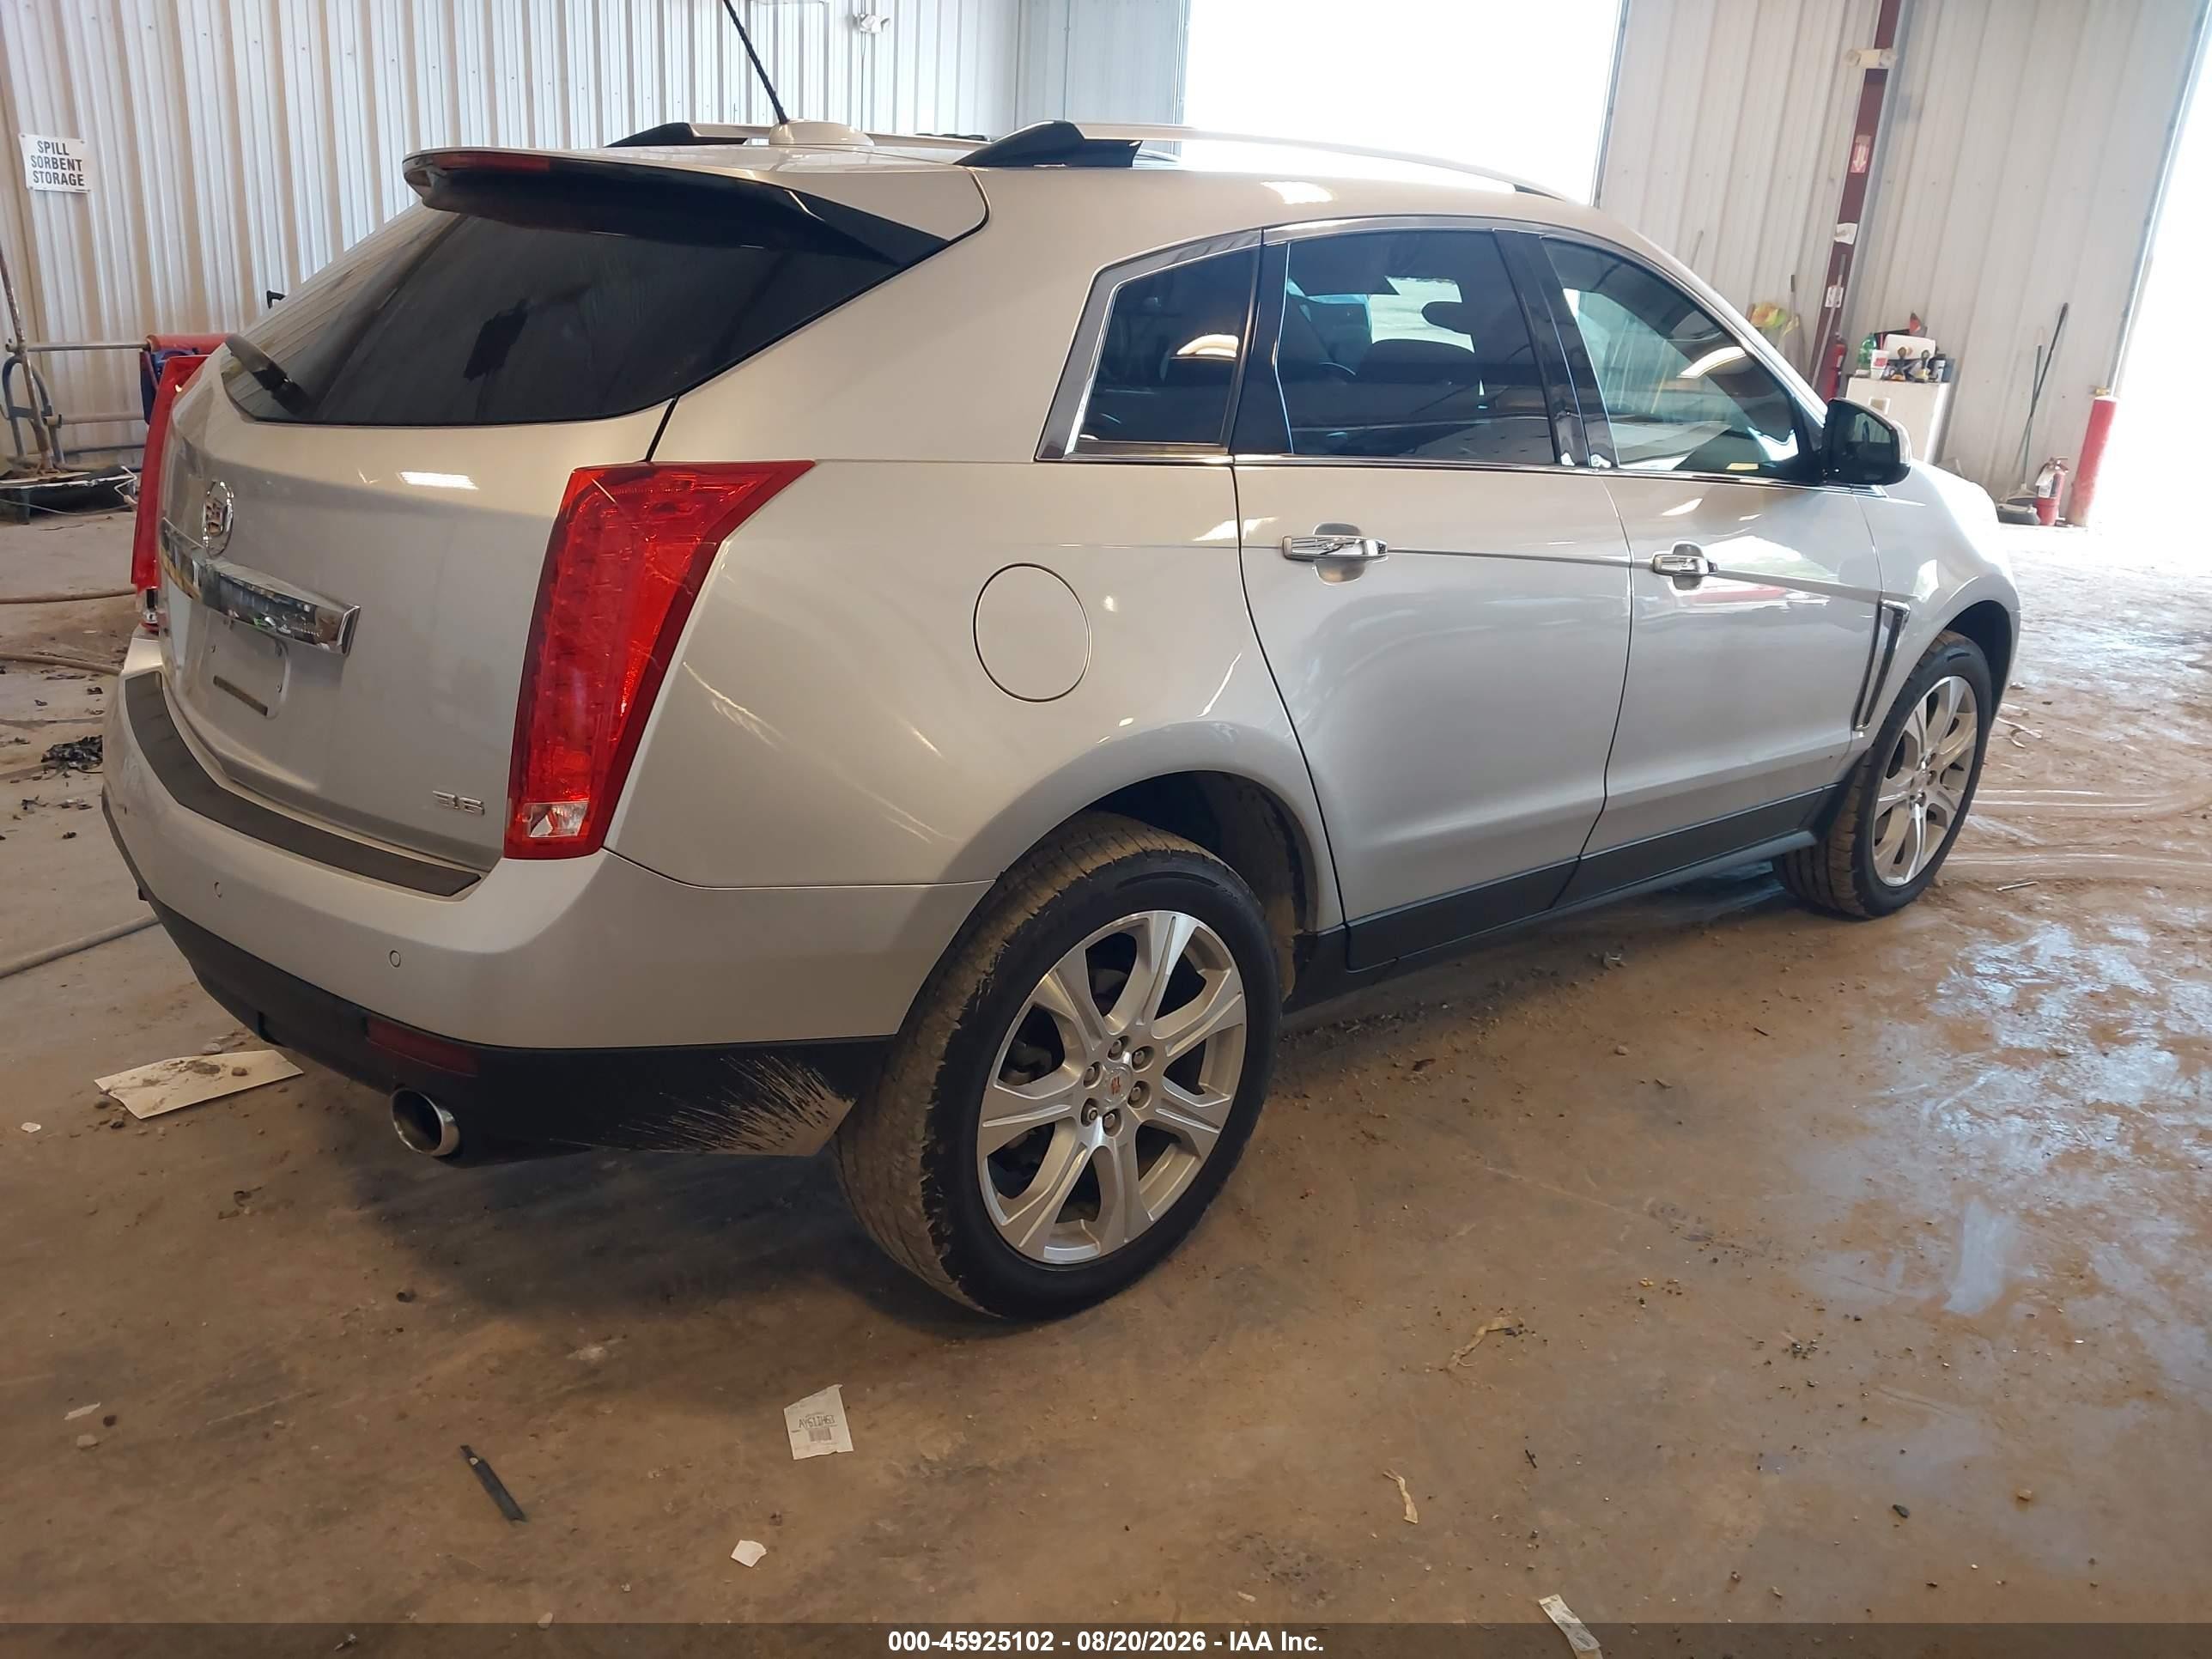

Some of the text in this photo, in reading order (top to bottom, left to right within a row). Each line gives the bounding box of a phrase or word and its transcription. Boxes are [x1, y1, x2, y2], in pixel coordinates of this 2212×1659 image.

[37, 140, 70, 155] SPILL
[30, 155, 82, 172] SORBENT
[33, 170, 85, 186] STORAGE
